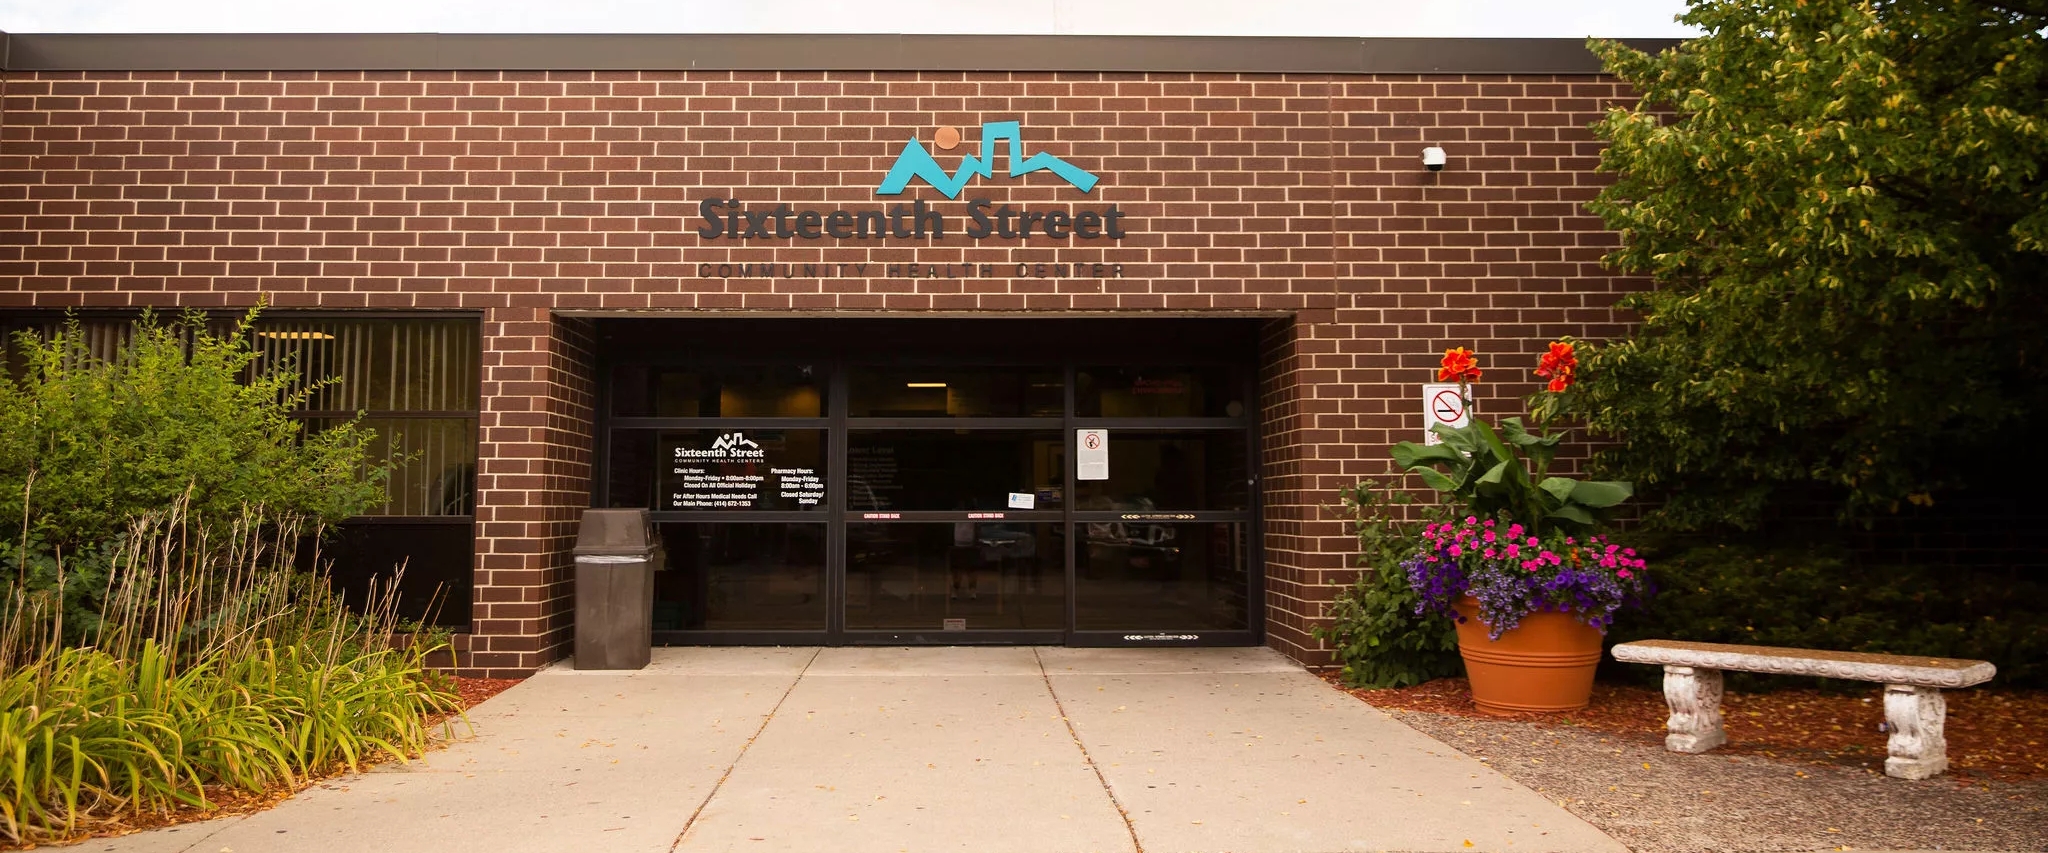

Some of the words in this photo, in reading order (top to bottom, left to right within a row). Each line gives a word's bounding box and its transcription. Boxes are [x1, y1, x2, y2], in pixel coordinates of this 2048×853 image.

[699, 197, 944, 239] Sixteenth
[966, 198, 1126, 239] Street
[699, 262, 868, 278] COMMUNITY
[888, 262, 993, 278] HEALTH
[1016, 262, 1125, 278] CENTER
[675, 448, 727, 457] Sixteenth
[730, 448, 764, 457] Street
